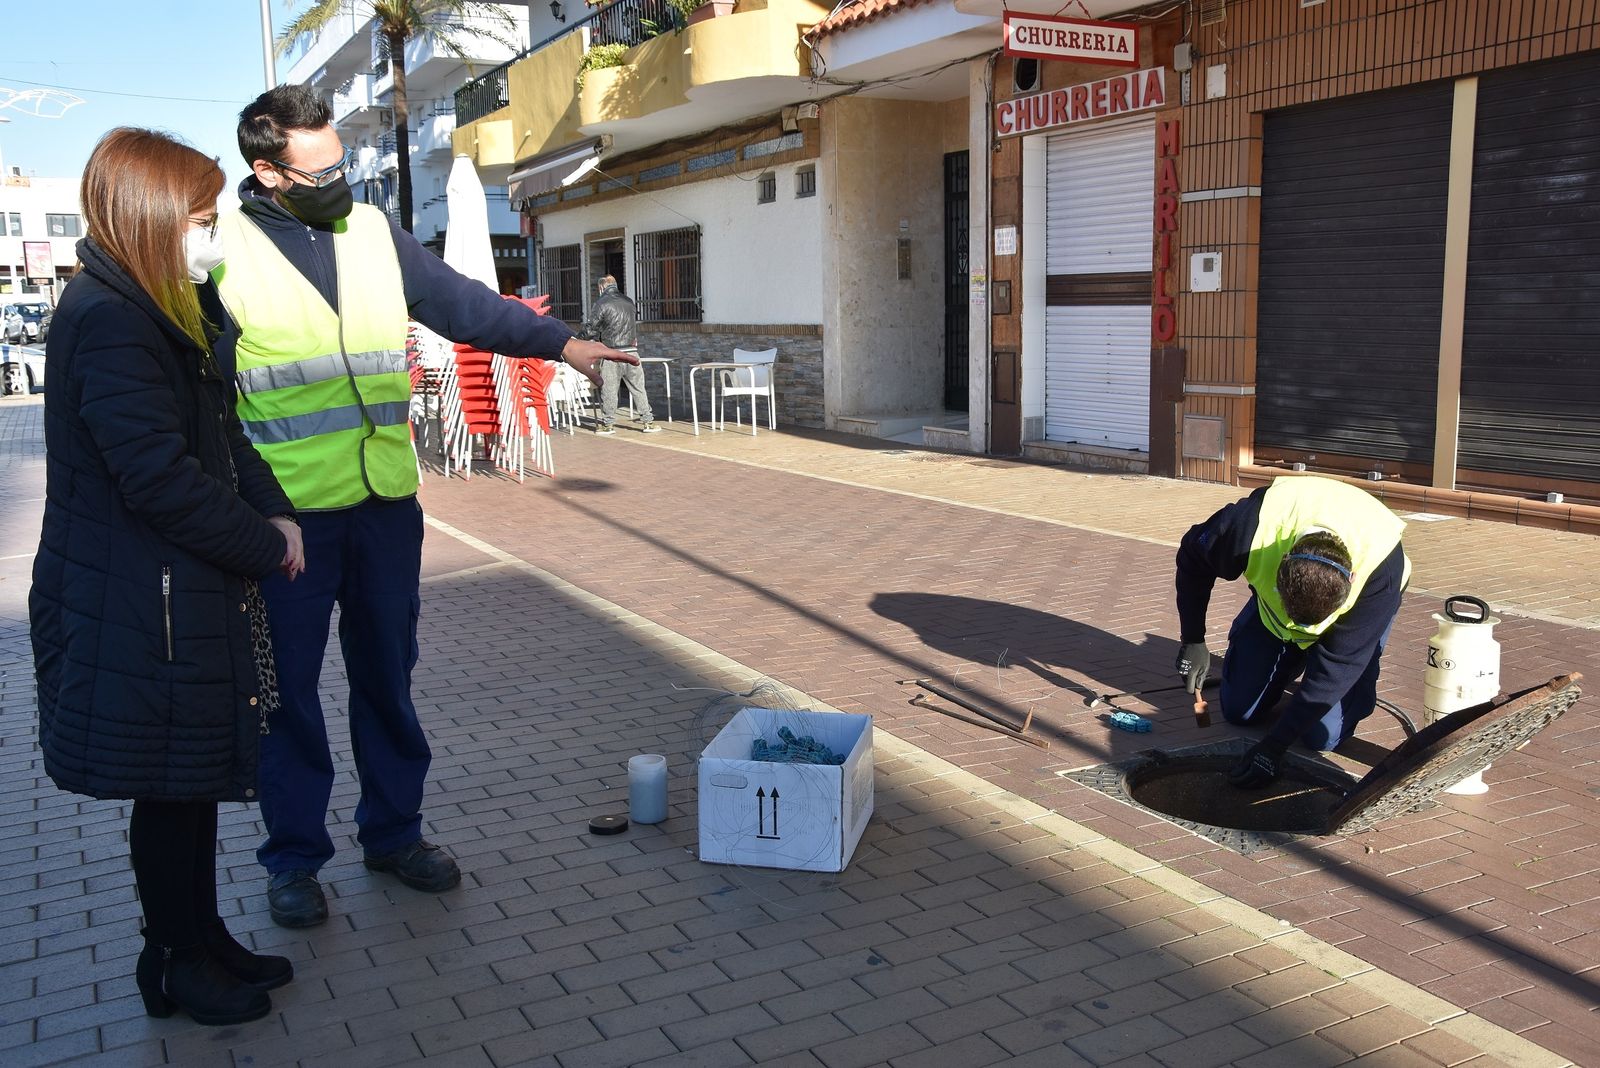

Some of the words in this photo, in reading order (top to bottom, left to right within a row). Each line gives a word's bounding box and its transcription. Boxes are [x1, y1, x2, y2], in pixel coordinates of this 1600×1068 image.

[1015, 25, 1129, 53] CHURRERIA
[997, 70, 1164, 134] CHURRERIA
[1154, 119, 1180, 342] MARILO
